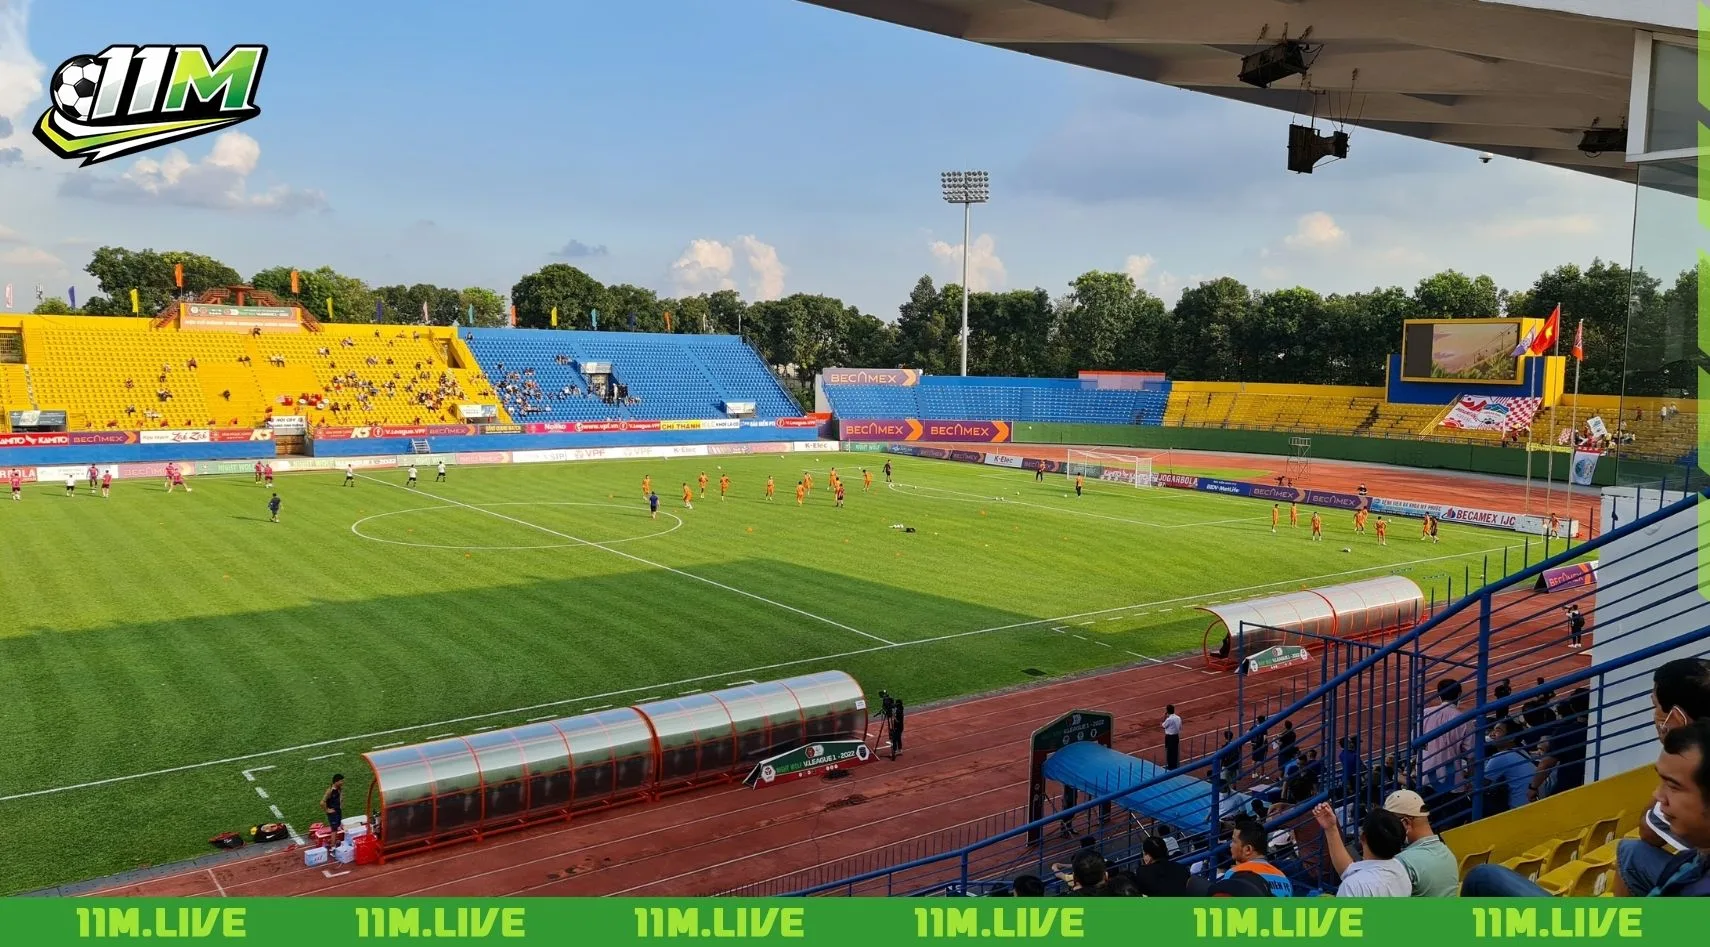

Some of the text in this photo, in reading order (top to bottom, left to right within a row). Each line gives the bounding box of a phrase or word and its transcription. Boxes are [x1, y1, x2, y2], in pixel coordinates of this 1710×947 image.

[831, 371, 897, 383] BECAMEX
[846, 422, 904, 435] BECAMEX
[931, 423, 989, 436] BECAMEX
[73, 434, 124, 443] BECAMEX
[1158, 473, 1198, 487] JOGARBOLA
[1253, 488, 1295, 499] BECAMEX
[1313, 495, 1356, 506] BECAMEX
[1456, 509, 1516, 526] BECAMEX IJC
[803, 756, 832, 767] V.LEAGUE
[840, 750, 855, 759] 2022
